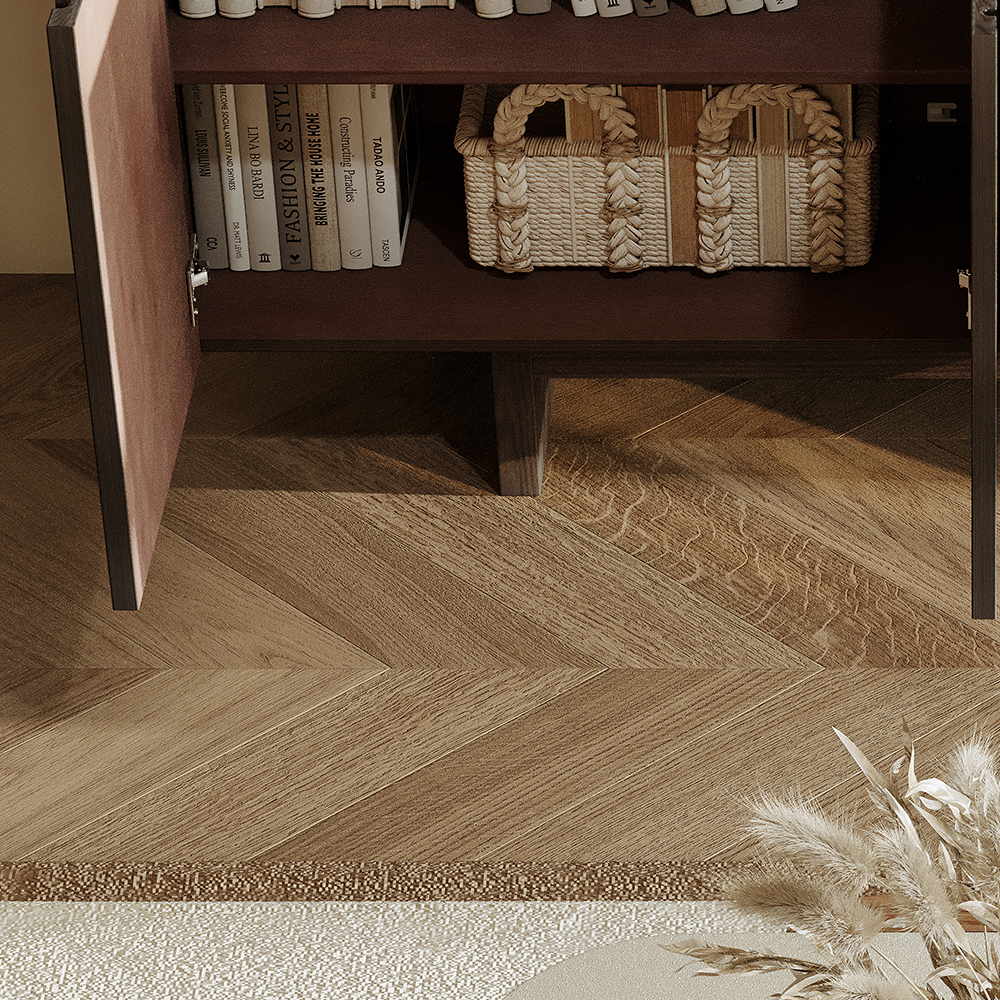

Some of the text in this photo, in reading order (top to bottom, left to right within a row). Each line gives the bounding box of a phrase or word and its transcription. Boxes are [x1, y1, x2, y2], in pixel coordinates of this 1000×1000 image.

[220, 84, 228, 110] VERCOME
[222, 111, 230, 130] SOCIAL
[224, 131, 232, 154] ANXIETY
[247, 126, 264, 200] LINA BO BARDI
[339, 116, 358, 204] Constructing Paradies
[227, 168, 236, 191] SHYNESS
[273, 84, 302, 244] FASHION & STYL
[306, 113, 328, 226] BRINGING THE HOUSE HOME
[372, 137, 386, 194] TADAO ANDO
[382, 239, 390, 262] TASCEN
